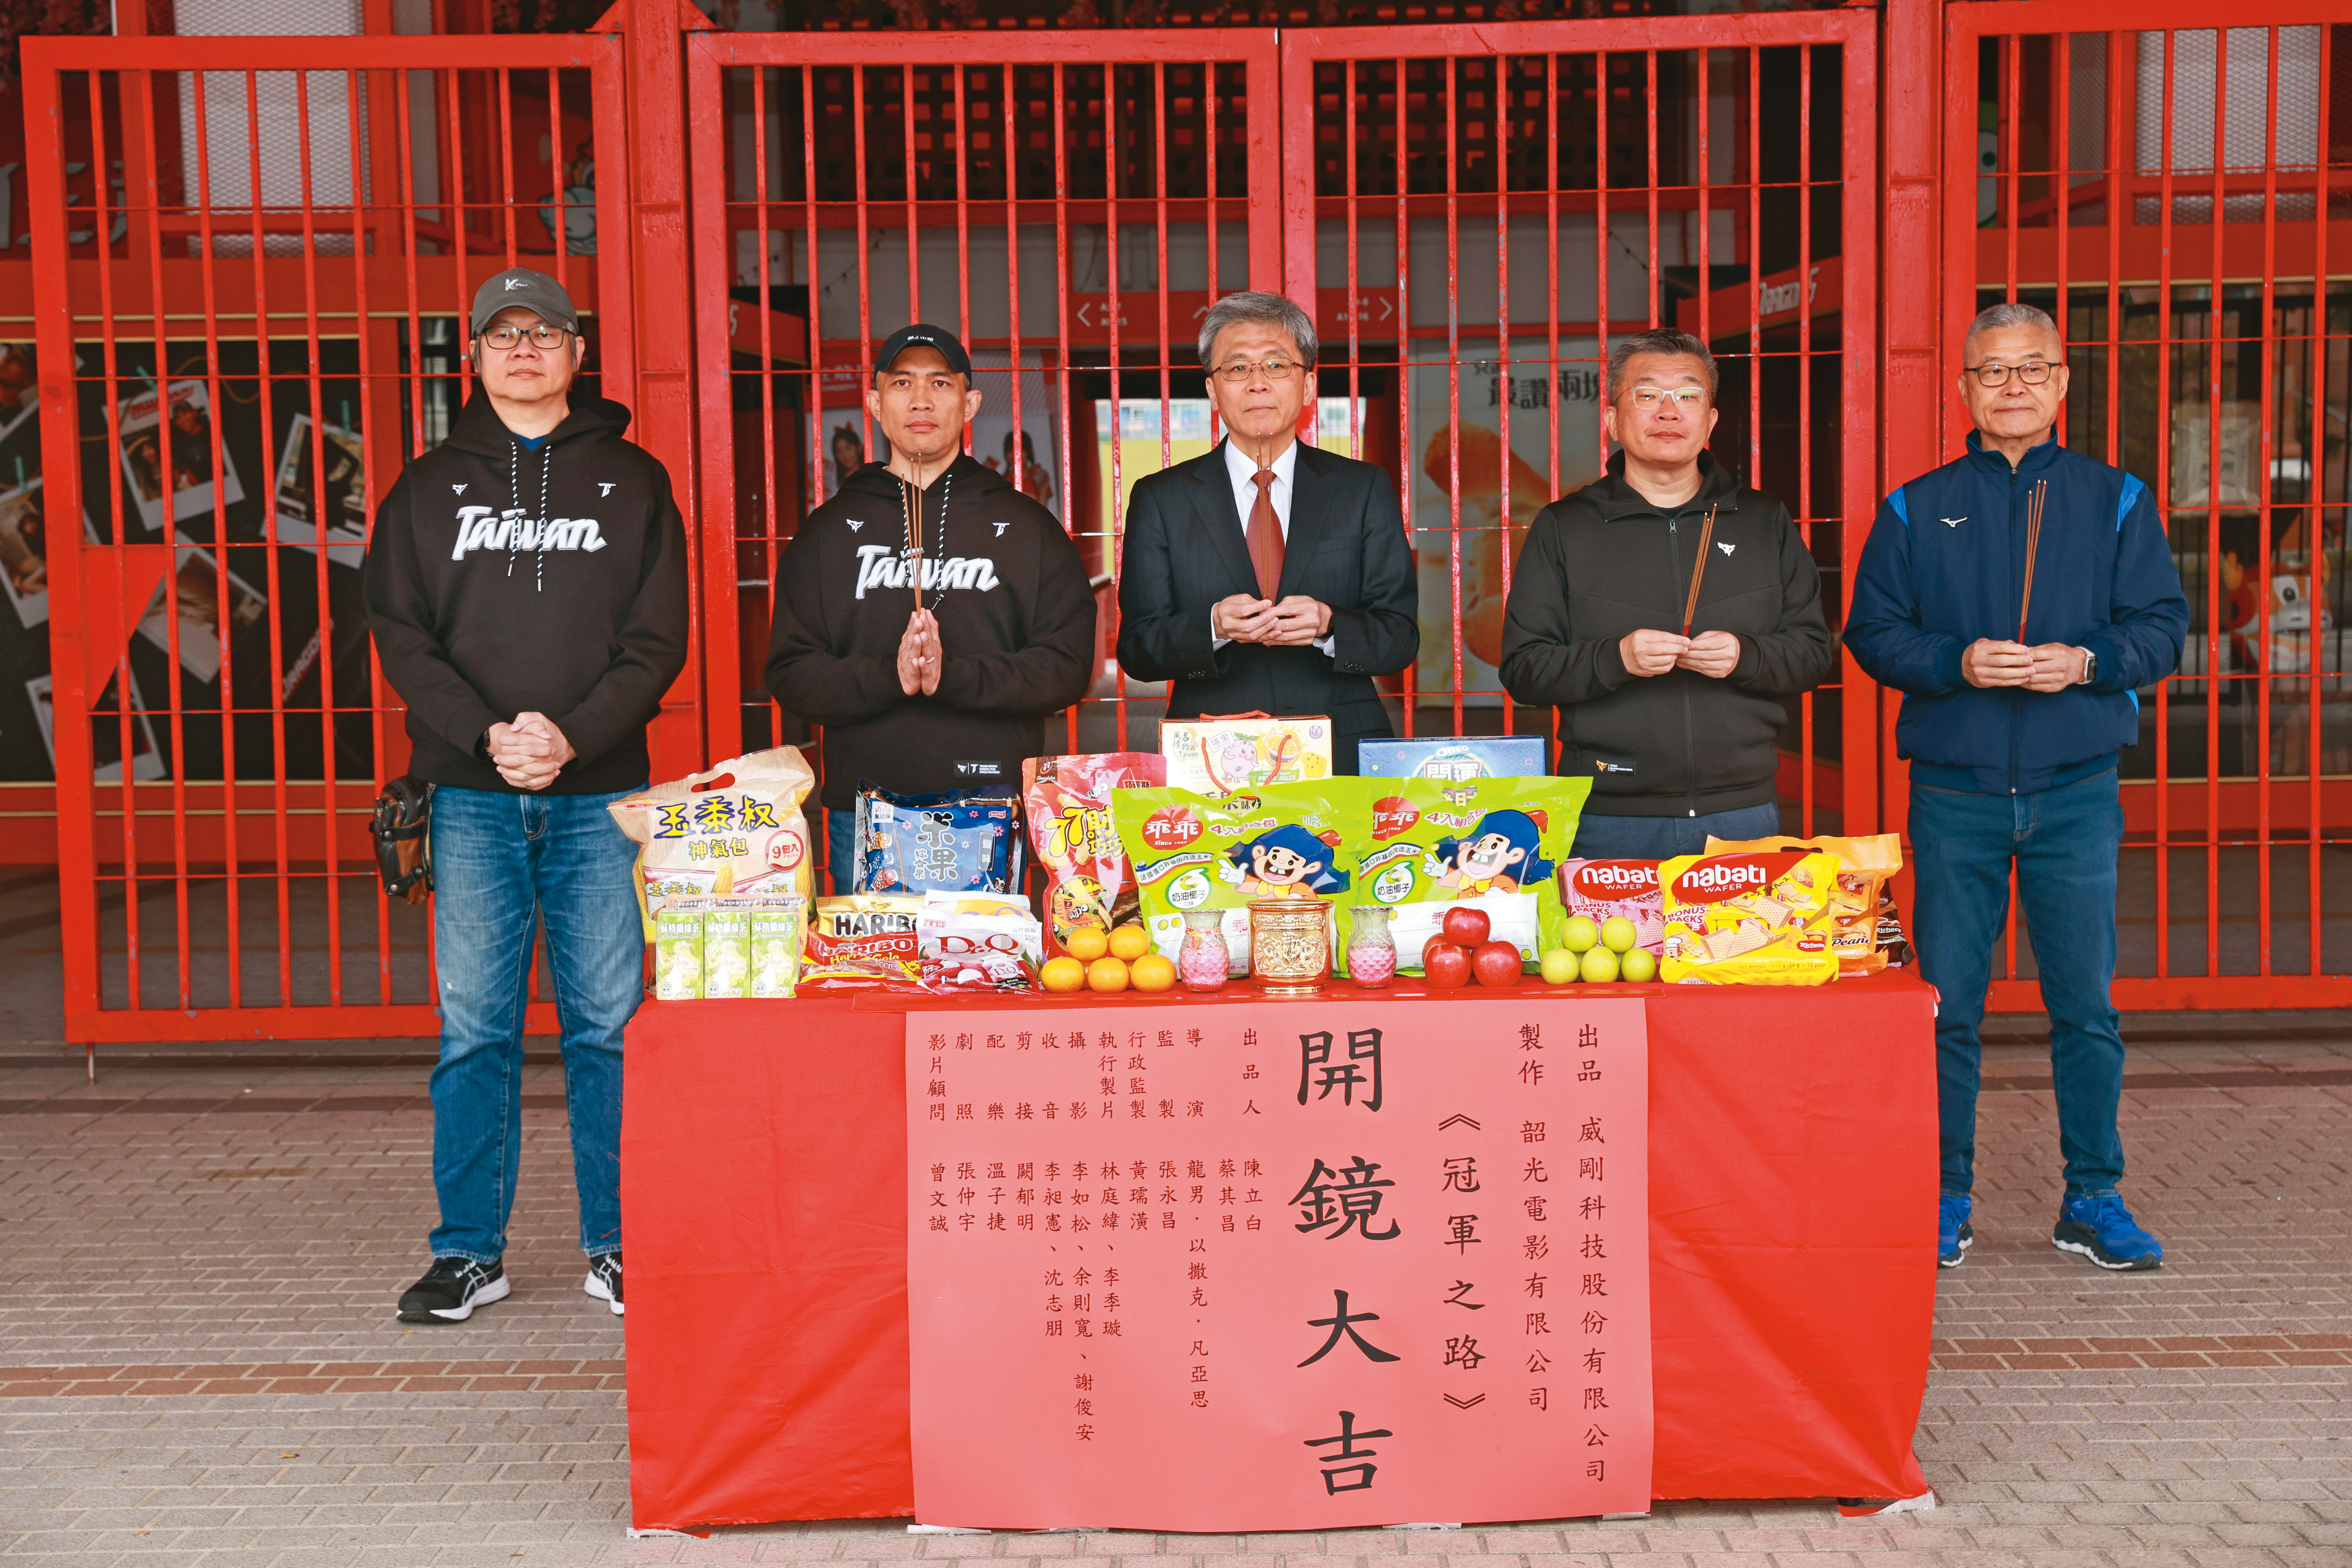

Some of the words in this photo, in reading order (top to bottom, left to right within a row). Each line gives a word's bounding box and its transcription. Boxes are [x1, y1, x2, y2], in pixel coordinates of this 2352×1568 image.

[452, 506, 608, 561] Taiwan
[855, 545, 1000, 599] Taiwan
[1210, 733, 1230, 746] 埔里
[1436, 745, 1469, 757] OREO
[1145, 819, 1199, 841] 乖乖
[1210, 819, 1276, 835] 4入組合包
[1373, 811, 1414, 829] 乖乖
[1426, 808, 1488, 828] 4入組合包
[689, 837, 749, 860] 神氣包
[772, 842, 799, 859] 9包入
[916, 811, 957, 882] 米果
[981, 838, 992, 864] 鹽味
[914, 848, 927, 880] 綜合果
[1140, 853, 1210, 881] 法國進口非基因改造玉米
[1682, 864, 1766, 888] nabati
[1171, 890, 1207, 903] 奶油椰子
[1377, 883, 1410, 896] 奶油椰子
[1704, 884, 1742, 893] WAFER
[753, 921, 793, 933] 蘇格蘭綠茶
[1668, 906, 1706, 918] BONUS
[1669, 915, 1704, 924] PACKS
[660, 922, 700, 935] 蘇格蘭綠茶
[707, 922, 747, 935] 蘇格蘭綠茶
[818, 938, 913, 956] HARIBO
[875, 961, 900, 971] HARIBO
[1519, 1023, 1544, 1086] 製作
[1577, 1023, 1602, 1082] 出品
[929, 1034, 946, 1122] 影片顧問
[1098, 1031, 1118, 1118] 執行製片
[1129, 1032, 1146, 1119] 行政監製
[1242, 1028, 1261, 1114] 出品人
[929, 1162, 949, 1232] 曾文誠
[957, 1162, 976, 1232] 張仲宇
[987, 1162, 1006, 1231] 溫子捷
[1017, 1162, 1034, 1231] 闕郁明
[1159, 1160, 1177, 1229] 張永昌
[1220, 1158, 1236, 1232] 蔡其昌
[1244, 1158, 1263, 1231] 陳立白
[1102, 1161, 1122, 1337] 林庭緯、李季璇
[1287, 1027, 1401, 1496] 開鏡大吉
[1438, 1113, 1486, 1410] 《冠軍之路》
[1520, 1120, 1552, 1412] 韶光電影有限公司
[1579, 1116, 1609, 1482] 威剛科技股份有限公司
